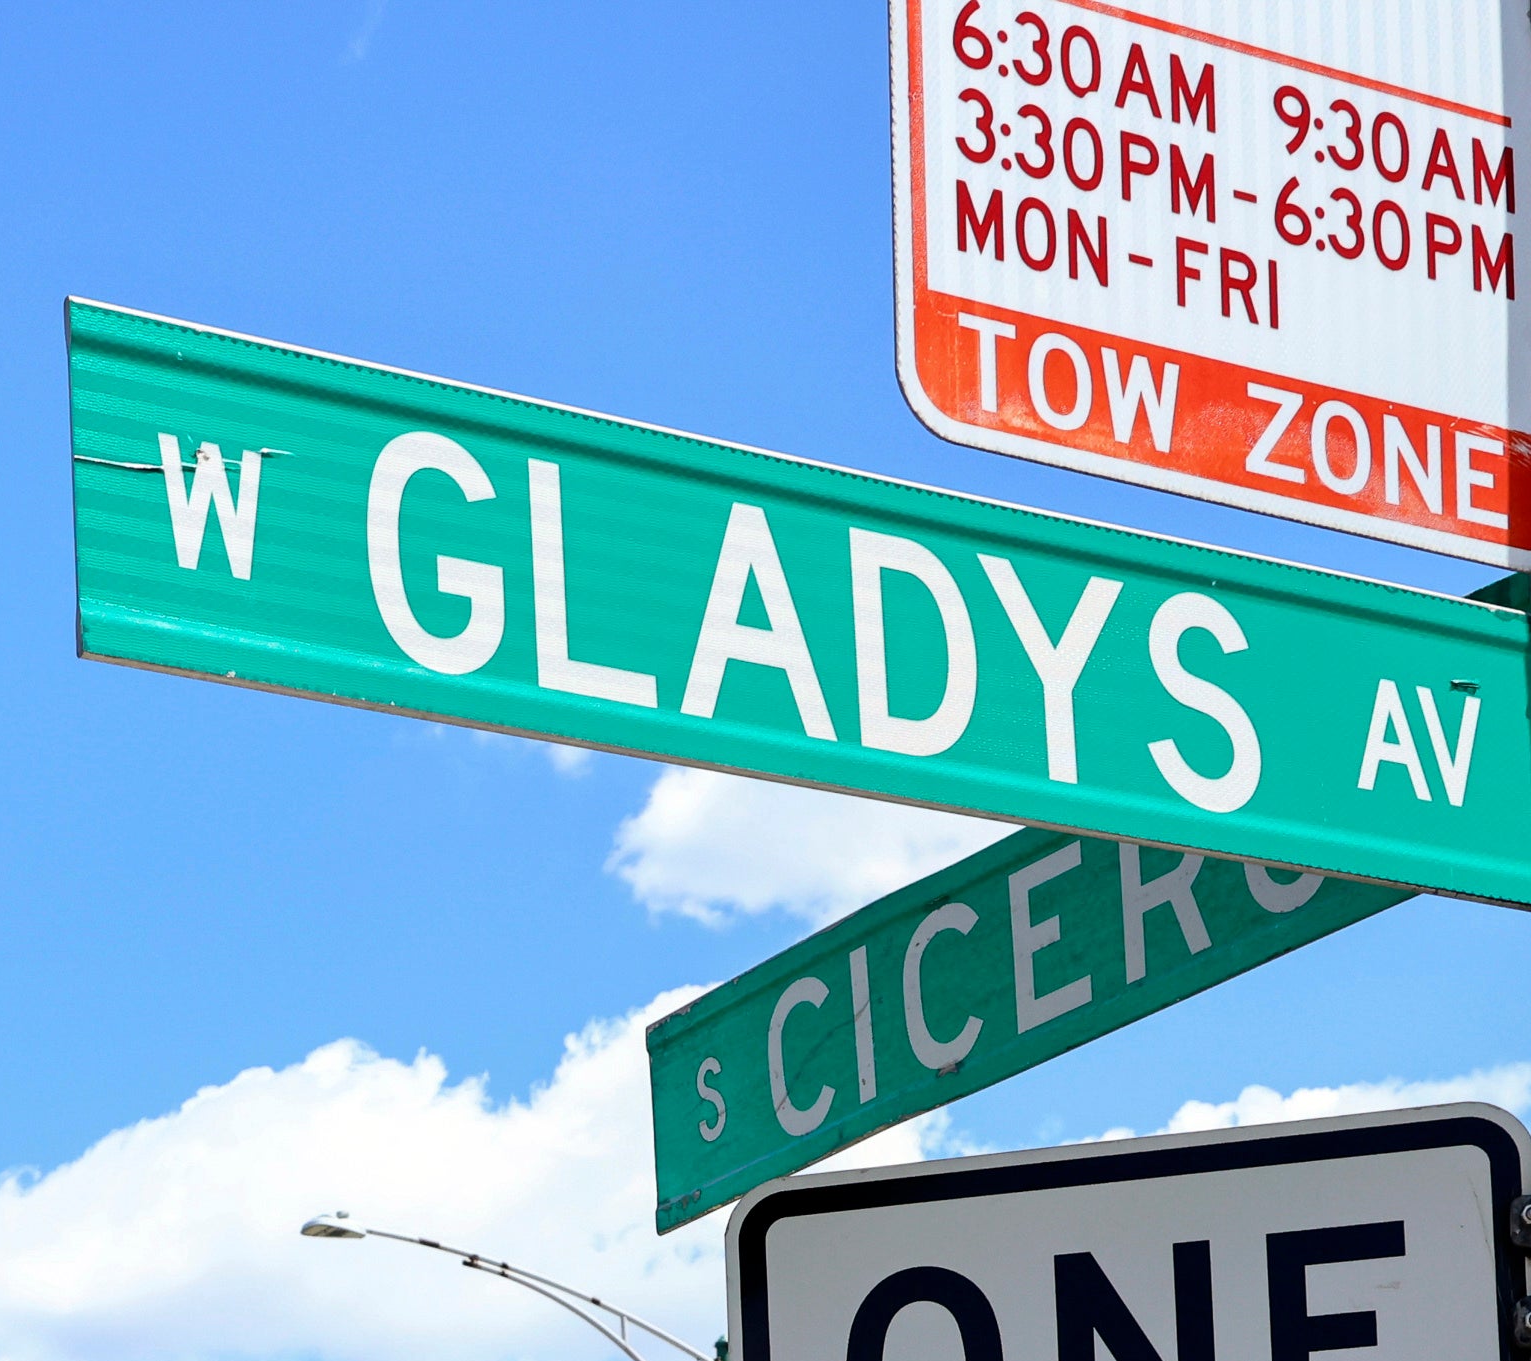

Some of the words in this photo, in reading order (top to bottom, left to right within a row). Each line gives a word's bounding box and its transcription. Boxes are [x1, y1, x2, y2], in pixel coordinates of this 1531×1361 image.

[957, 311, 1181, 454] TOW
[1245, 382, 1509, 531] ZONE
[157, 433, 263, 581] W
[365, 430, 1262, 813] GLADYS
[1357, 678, 1481, 807] AV
[695, 1056, 728, 1143] S
